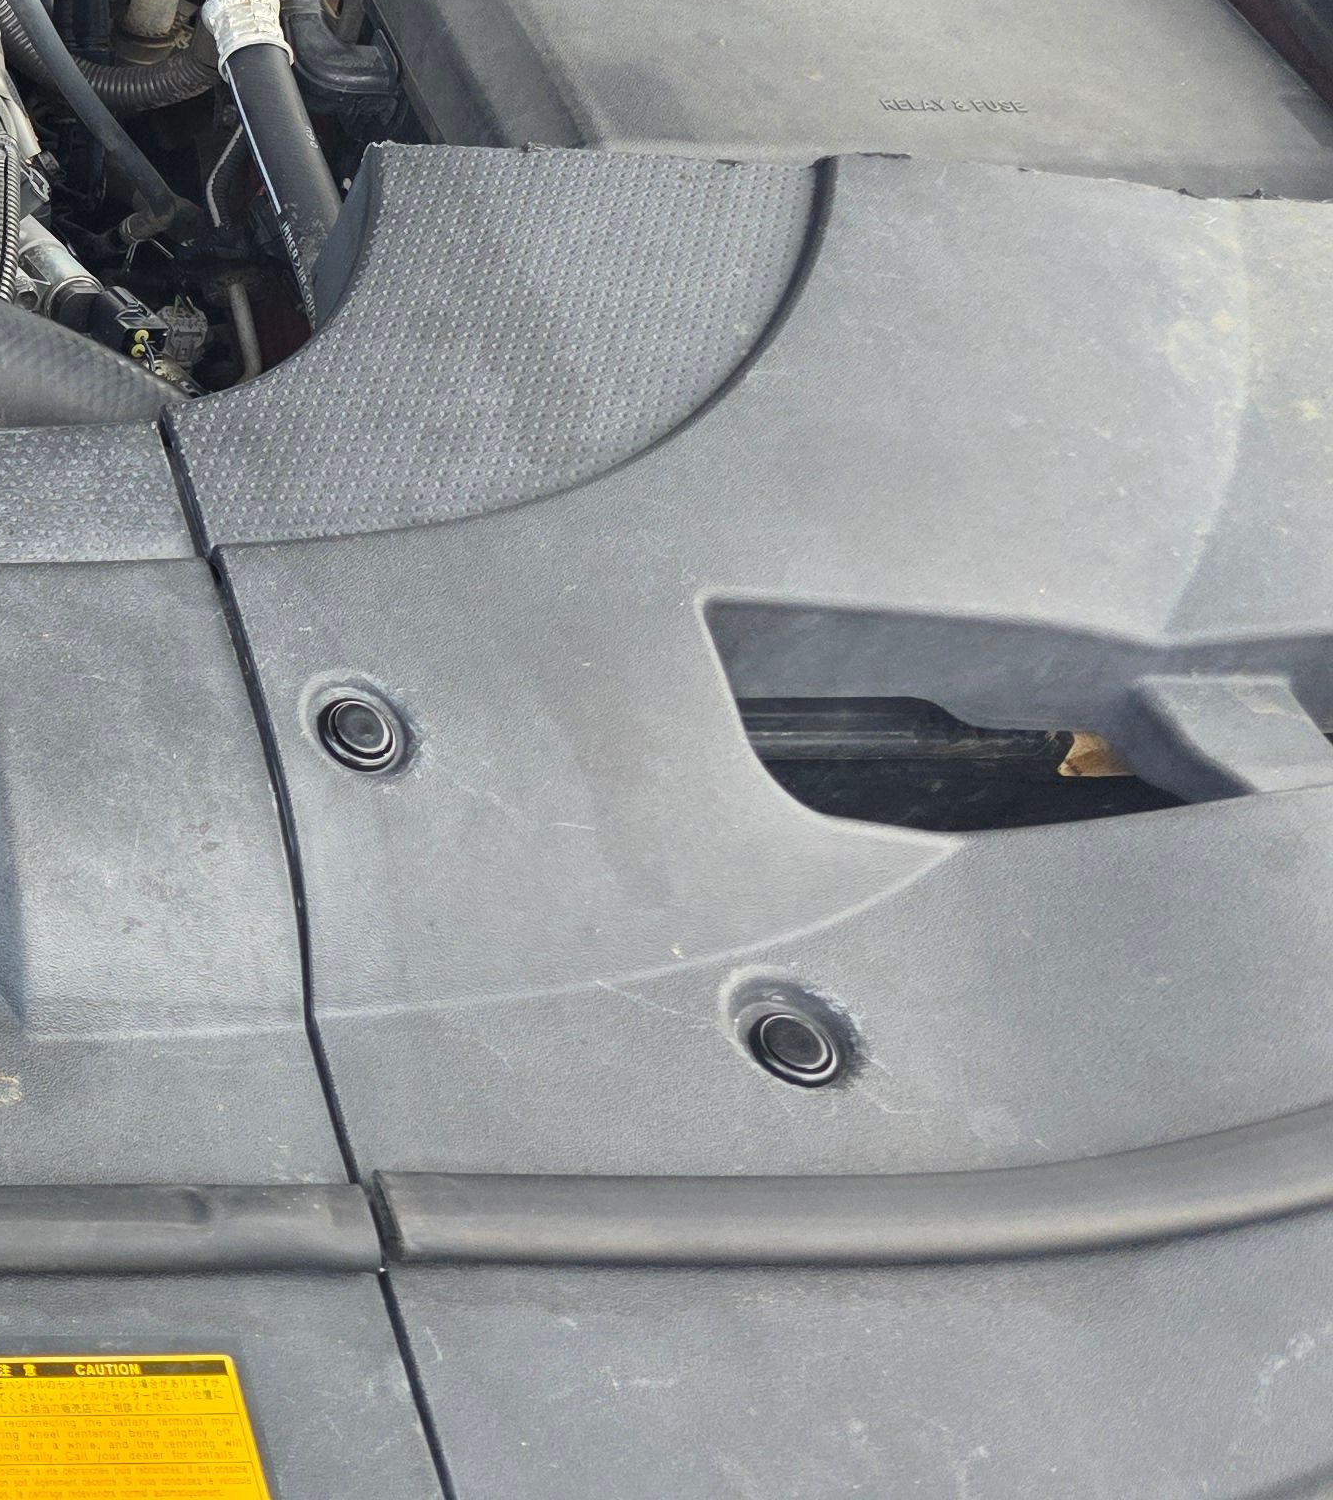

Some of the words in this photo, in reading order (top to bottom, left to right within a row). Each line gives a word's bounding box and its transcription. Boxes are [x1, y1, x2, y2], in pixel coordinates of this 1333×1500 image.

[879, 98, 946, 112] RELAY
[951, 99, 970, 112] &
[970, 99, 1029, 113] FUSE
[74, 1363, 143, 1376] CAUTION
